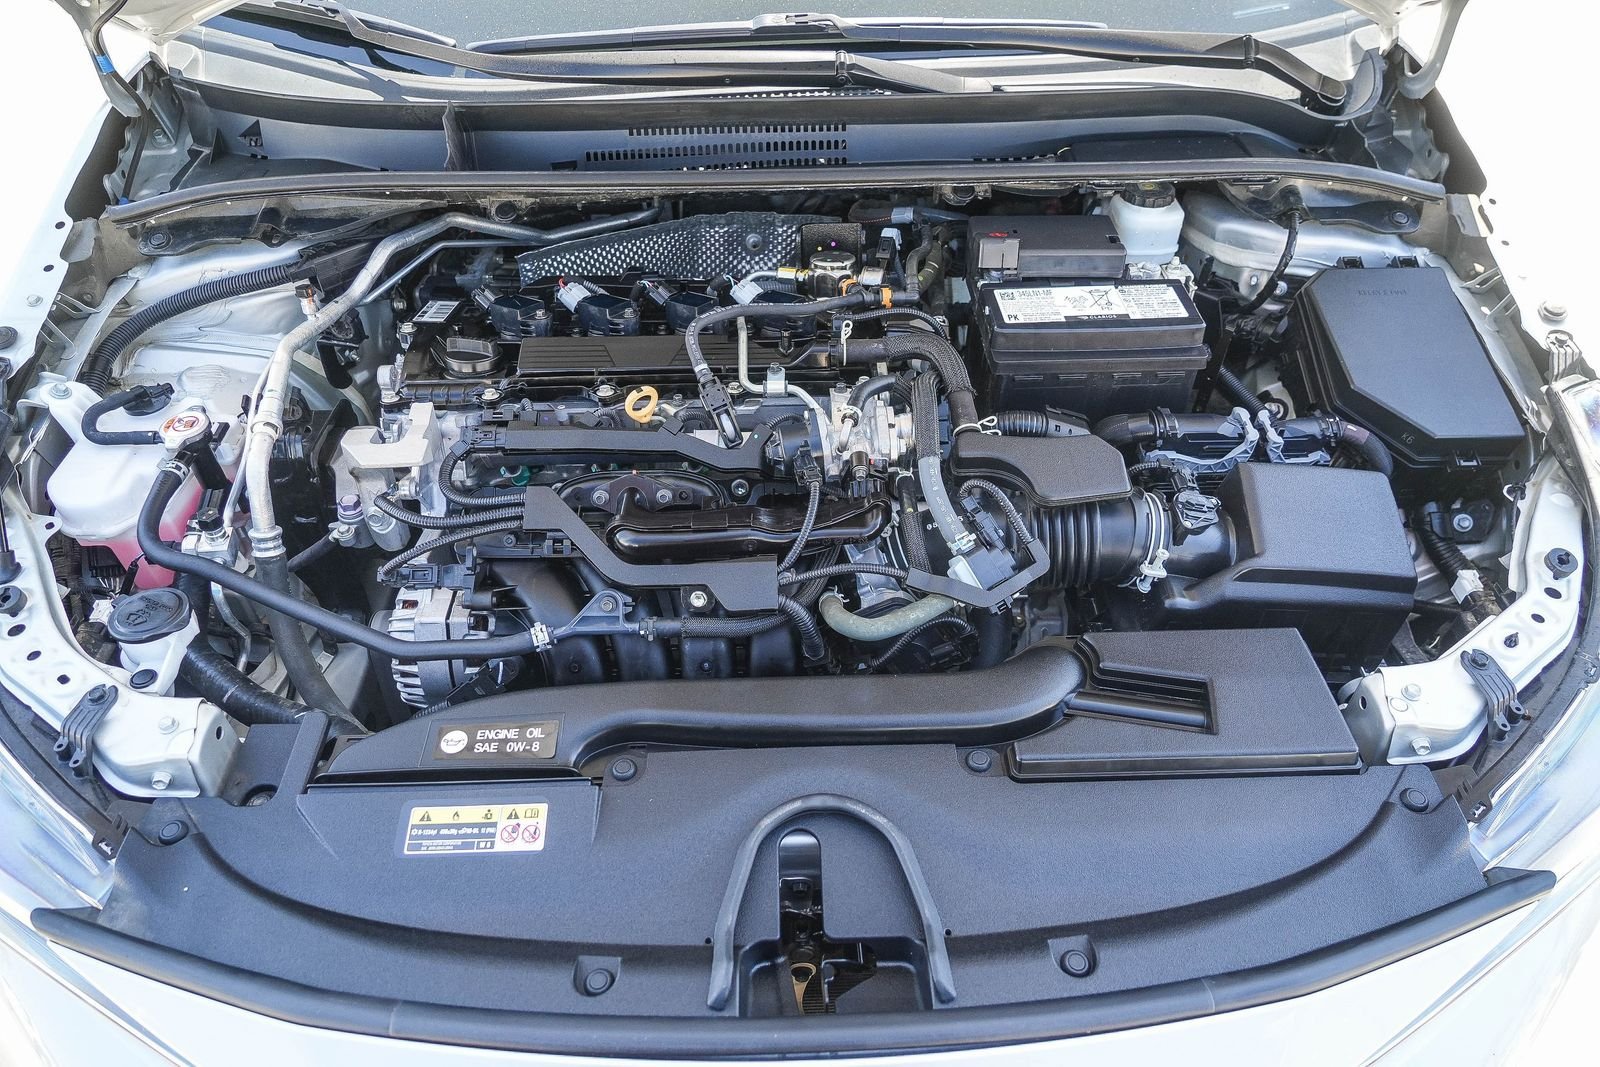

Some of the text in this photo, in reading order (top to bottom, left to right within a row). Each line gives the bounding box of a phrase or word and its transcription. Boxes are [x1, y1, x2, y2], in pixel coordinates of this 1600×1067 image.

[476, 727, 545, 740] ENGINE OIL
[473, 741, 540, 753] SAE 0W-8
